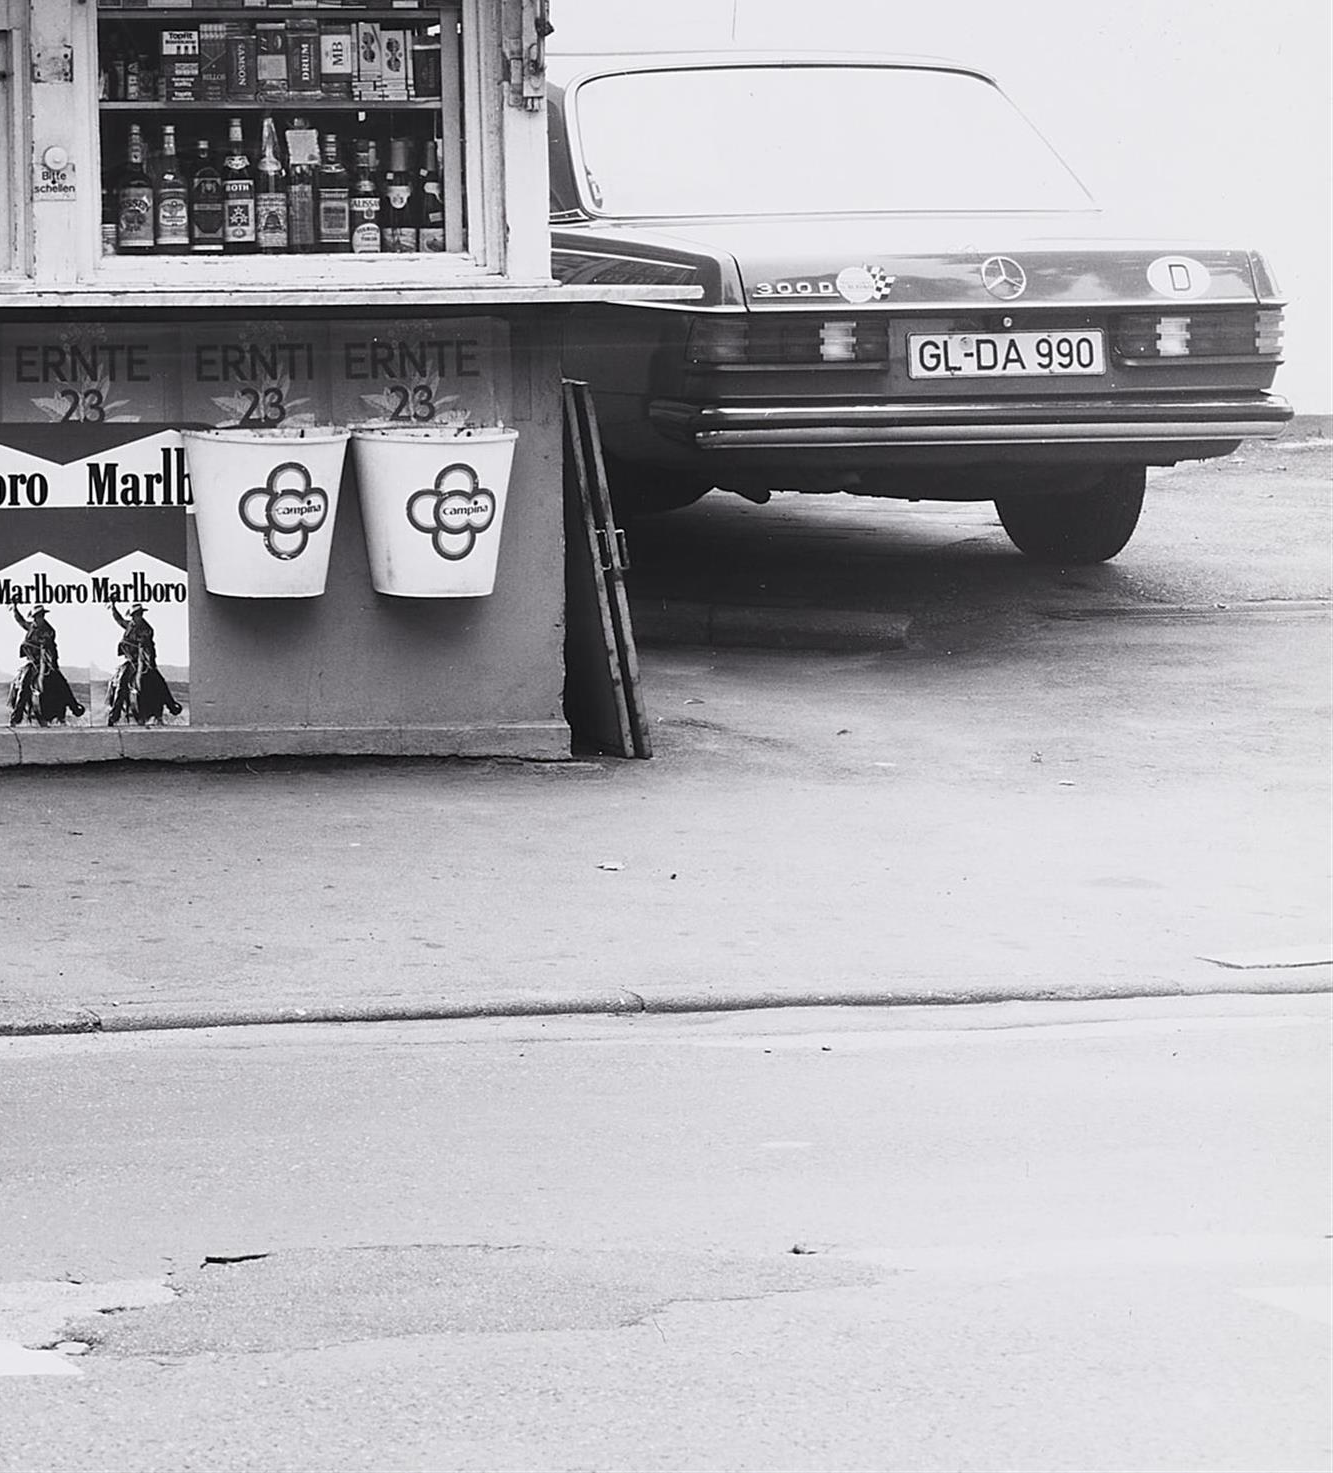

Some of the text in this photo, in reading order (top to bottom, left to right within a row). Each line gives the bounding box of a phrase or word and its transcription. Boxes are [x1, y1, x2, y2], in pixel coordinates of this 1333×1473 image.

[301, 43, 310, 80] DRUM
[34, 183, 76, 194] schellen
[756, 281, 813, 295] 300
[1168, 263, 1190, 292] D
[16, 344, 151, 384] ERNTE
[343, 339, 482, 381] ERNTE
[918, 336, 1095, 374] GL-DA 990
[443, 499, 489, 517] campina
[91, 571, 187, 604] Marlboro
